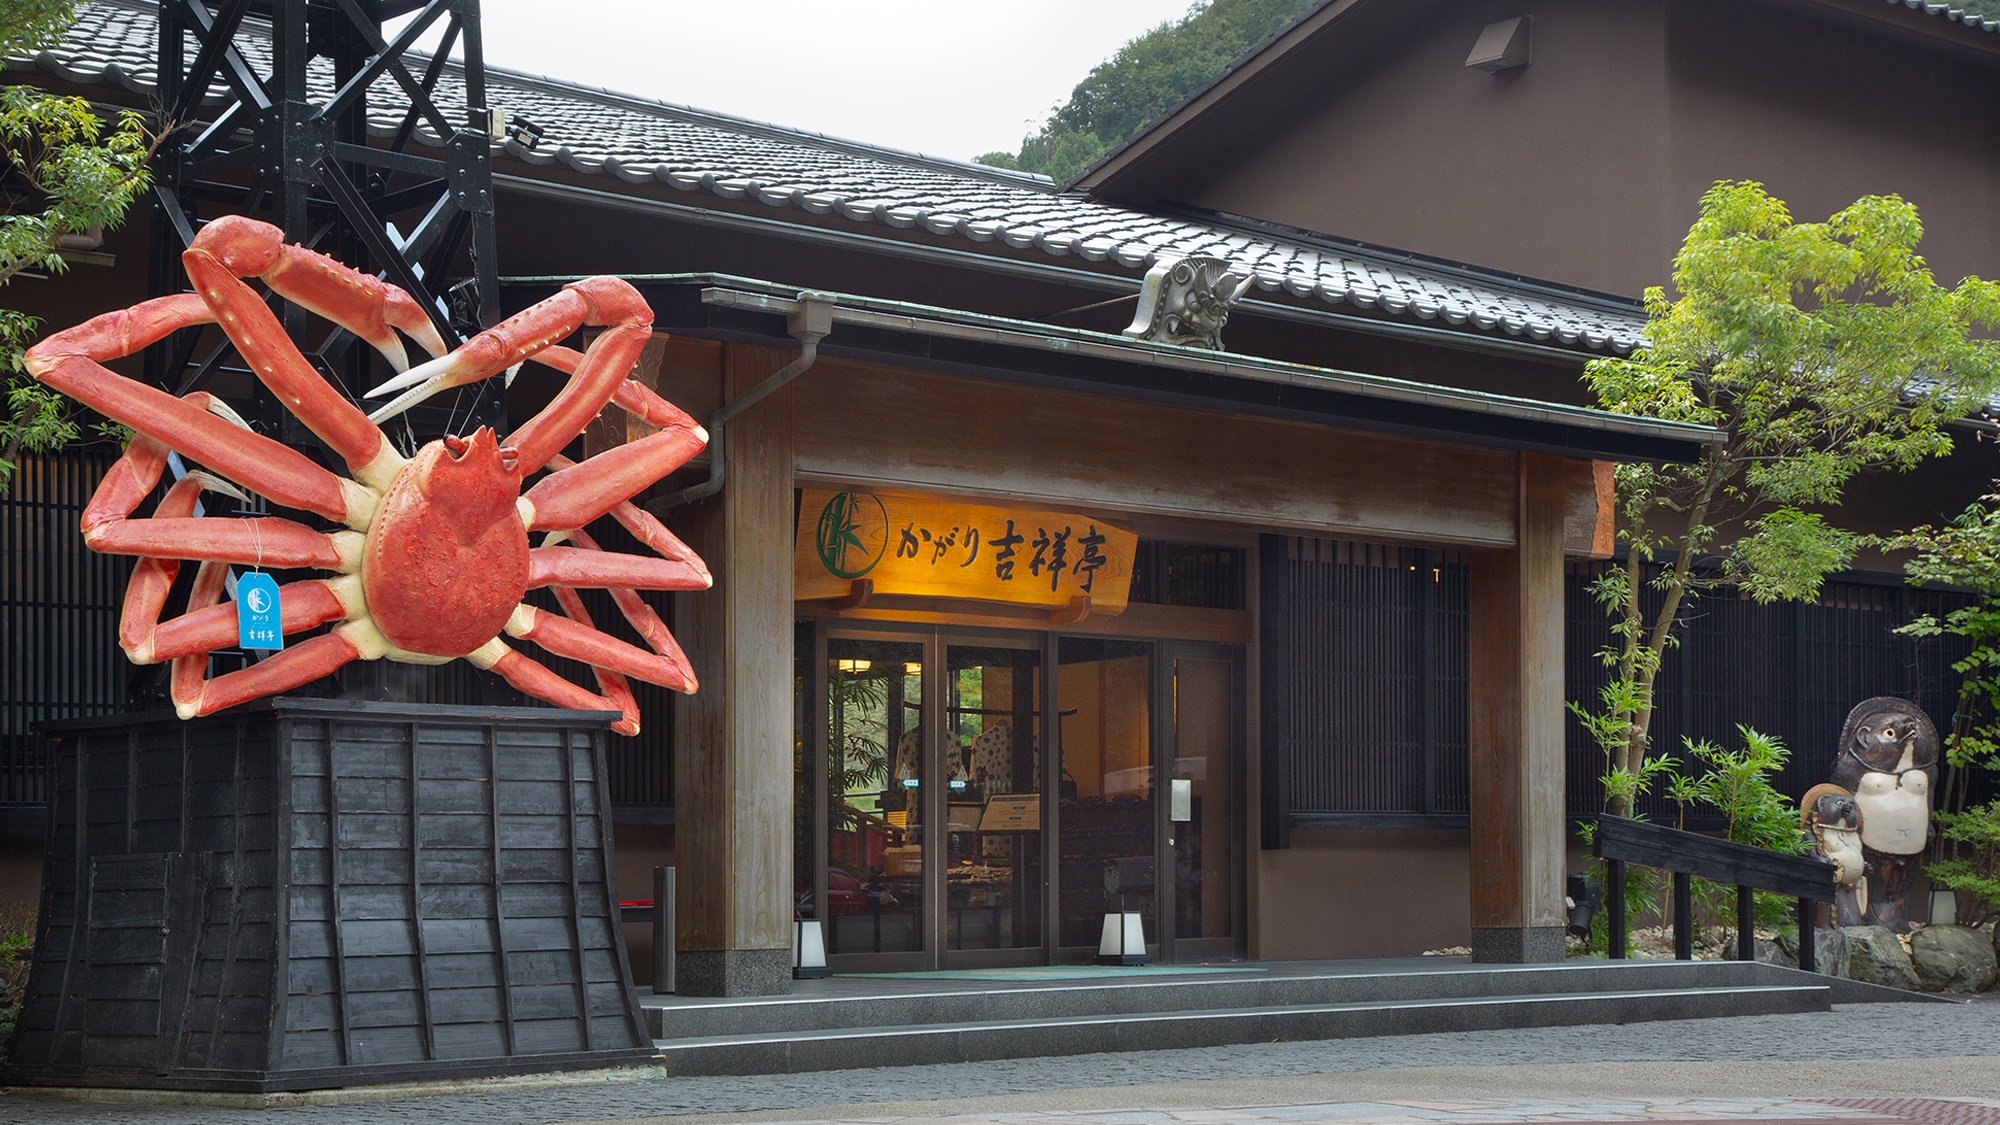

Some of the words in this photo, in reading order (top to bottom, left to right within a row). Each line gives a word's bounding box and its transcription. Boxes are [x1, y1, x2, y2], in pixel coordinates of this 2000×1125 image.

[897, 520, 1107, 594] かがり吉祥亭
